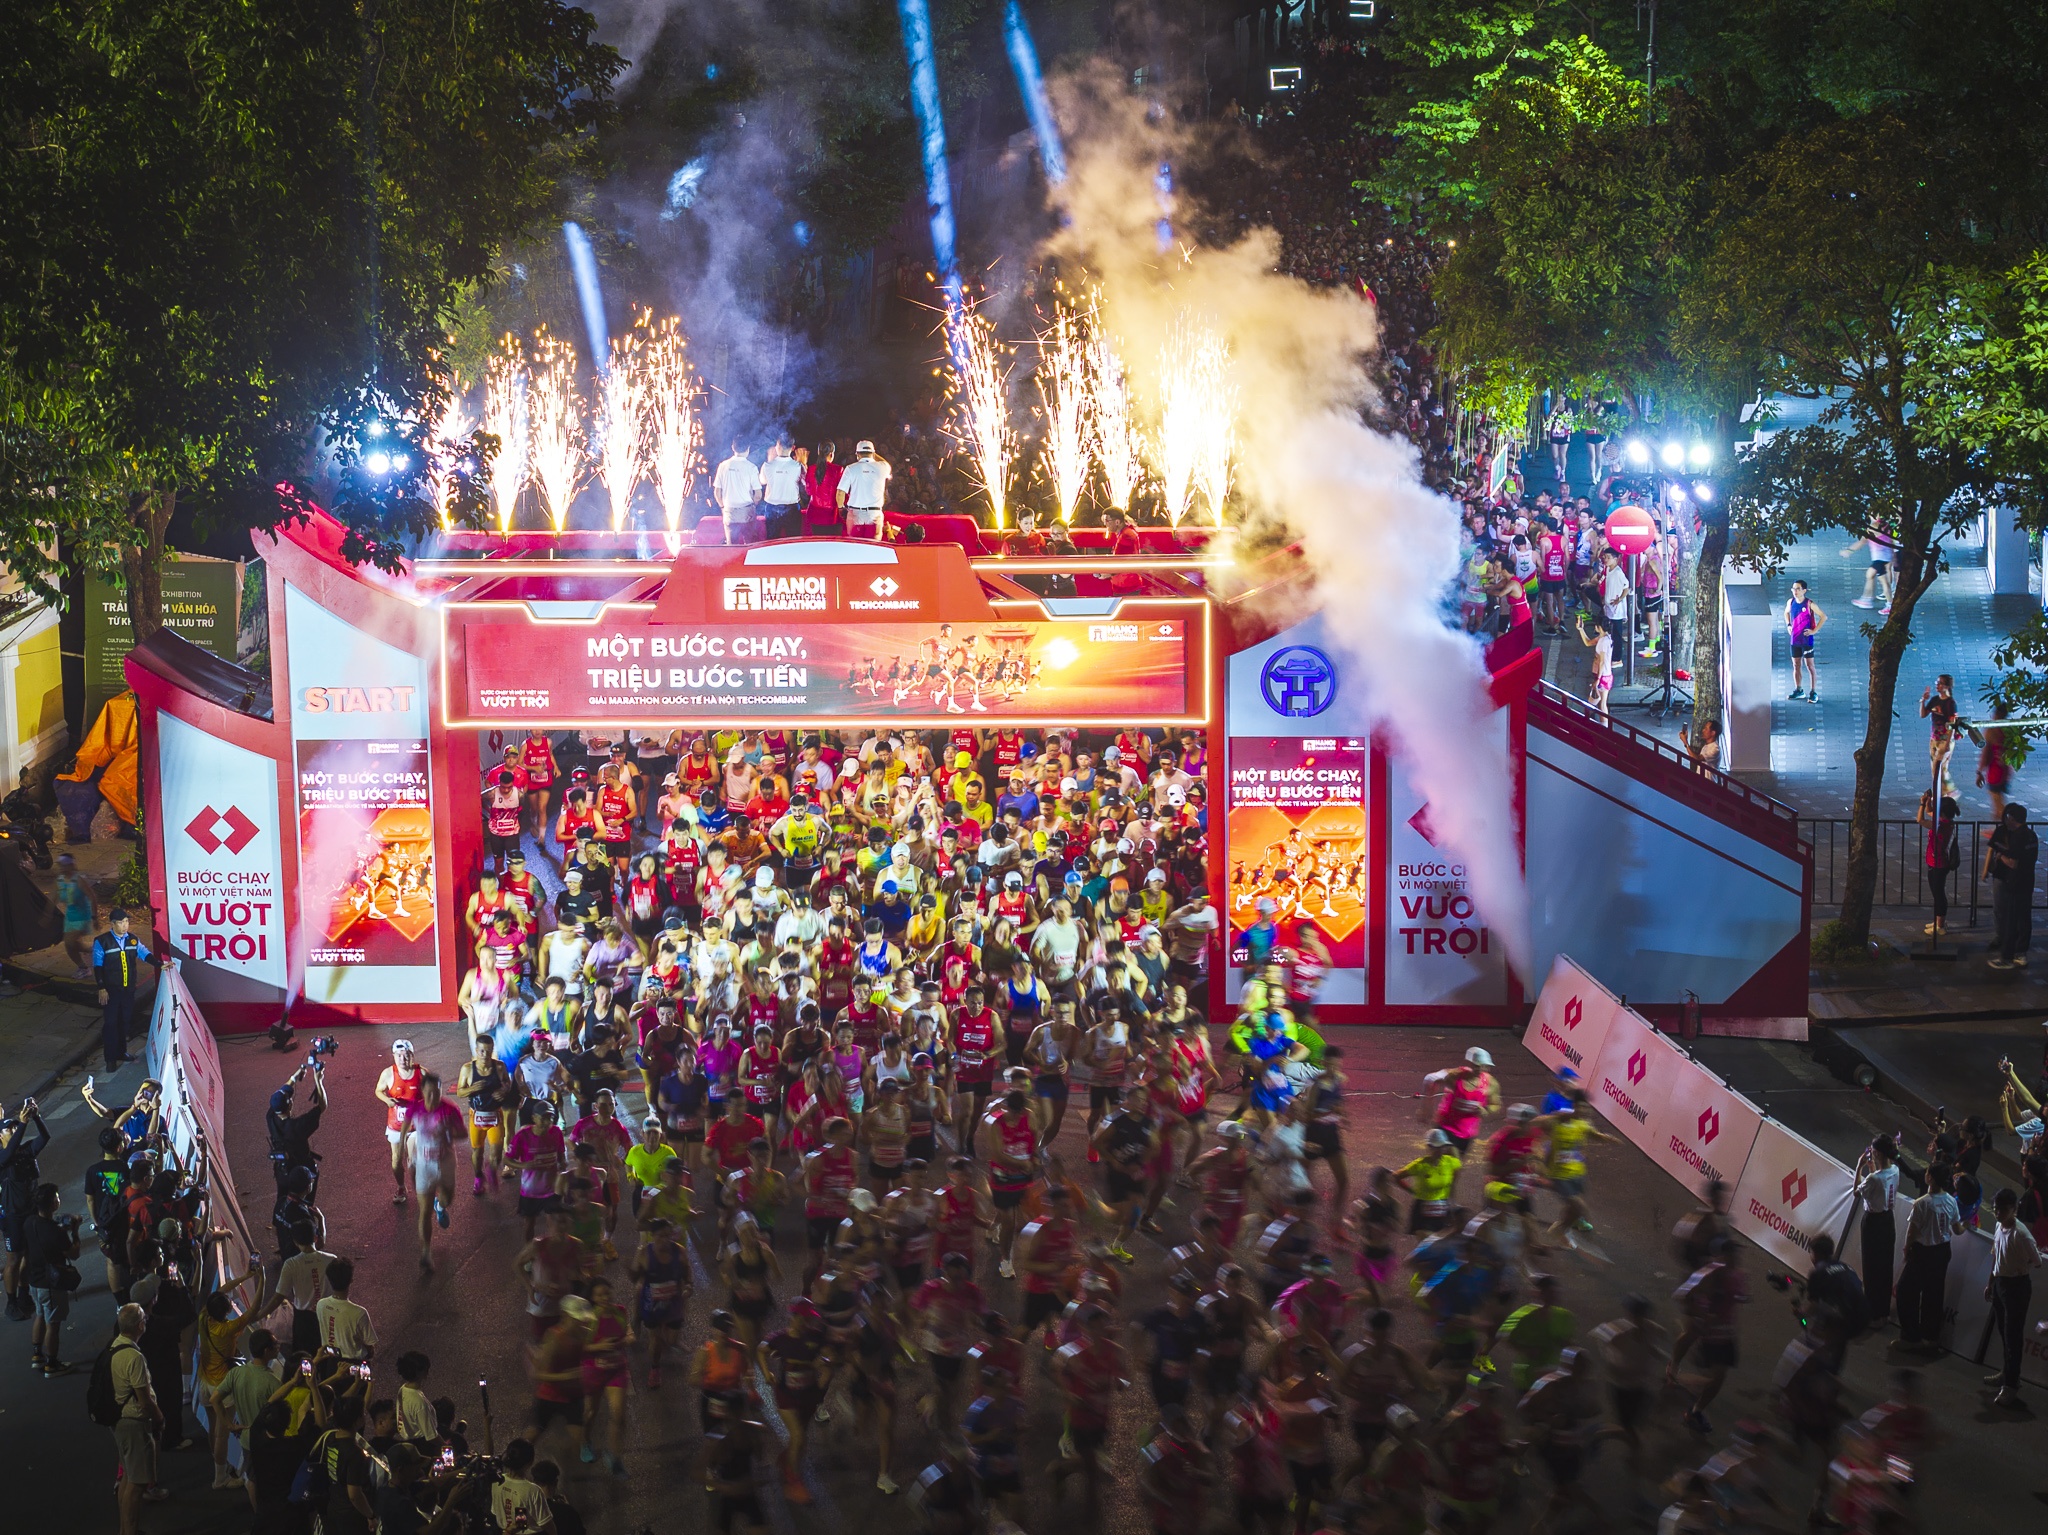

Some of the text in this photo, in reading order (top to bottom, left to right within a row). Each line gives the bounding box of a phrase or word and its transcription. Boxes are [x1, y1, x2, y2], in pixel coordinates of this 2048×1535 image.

[161, 590, 202, 598] EXHIBITION
[762, 577, 826, 594] HANOI
[171, 602, 193, 614] VĂN
[195, 602, 217, 615] HÓA
[762, 600, 826, 610] MARATHON
[849, 601, 920, 610] TECHCOMBANK
[587, 633, 807, 662] MỘT BƯỚC CHẠY,
[587, 664, 807, 693] TRIỆU BƯỚC TIẾN
[305, 686, 414, 713] START
[480, 694, 550, 709] VƯỢT TRỘI
[608, 696, 658, 705] MARATHON
[662, 694, 690, 705] QUỐC
[703, 695, 718, 704] HÀ
[737, 696, 807, 704] TECHCOMBANK
[302, 771, 427, 787] MỘT BƯỚC CHẠY,
[1232, 767, 1361, 784] MỘT BƯỚC CHẠY,
[302, 785, 427, 802] TRIỆU BƯỚC TIẾN
[1232, 783, 1361, 800] TRIỆU BƯỚC TIẾN
[178, 868, 270, 887] BƯỚC CHẠY
[1399, 861, 1446, 877] BƯỚC
[179, 885, 272, 899] VÌ MỘT VIỆT NAM
[1399, 878, 1467, 892] VÌ MỘT VIỆT
[179, 898, 272, 932] VƯỢT
[1399, 891, 1475, 925] VƯỢ
[181, 930, 267, 965] TRỘI
[1399, 924, 1489, 959] TRỘI
[310, 951, 366, 963] VƯỢT TRỘI
[1539, 1023, 1584, 1069] TECHCOMBANK
[1602, 1077, 1649, 1126] TECHCOMBANK
